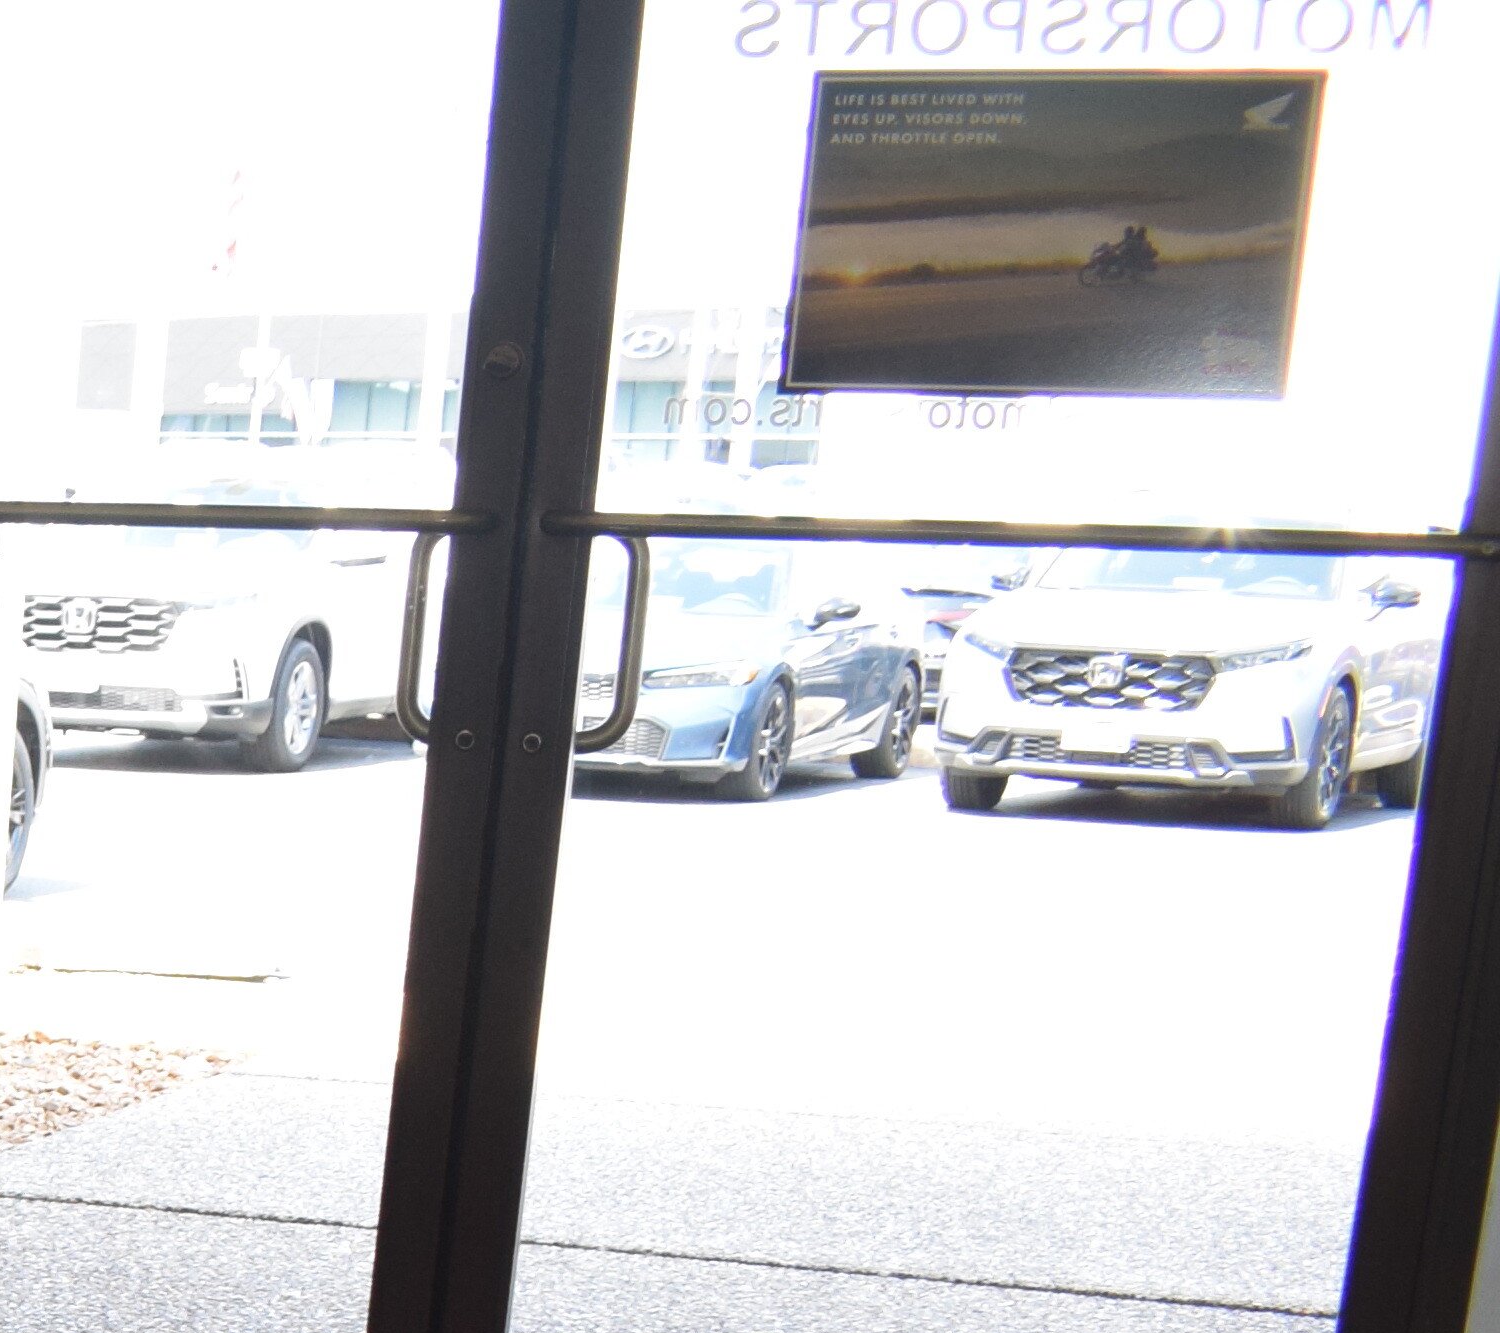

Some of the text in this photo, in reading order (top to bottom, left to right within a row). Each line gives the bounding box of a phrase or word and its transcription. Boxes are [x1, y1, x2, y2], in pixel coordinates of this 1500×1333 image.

[834, 94, 1025, 106] LIFE IS BEST LIVED WITH
[832, 113, 869, 125] EYES
[905, 113, 964, 125] VISORS
[830, 133, 865, 144] AND
[871, 133, 947, 144] THROTTLE
